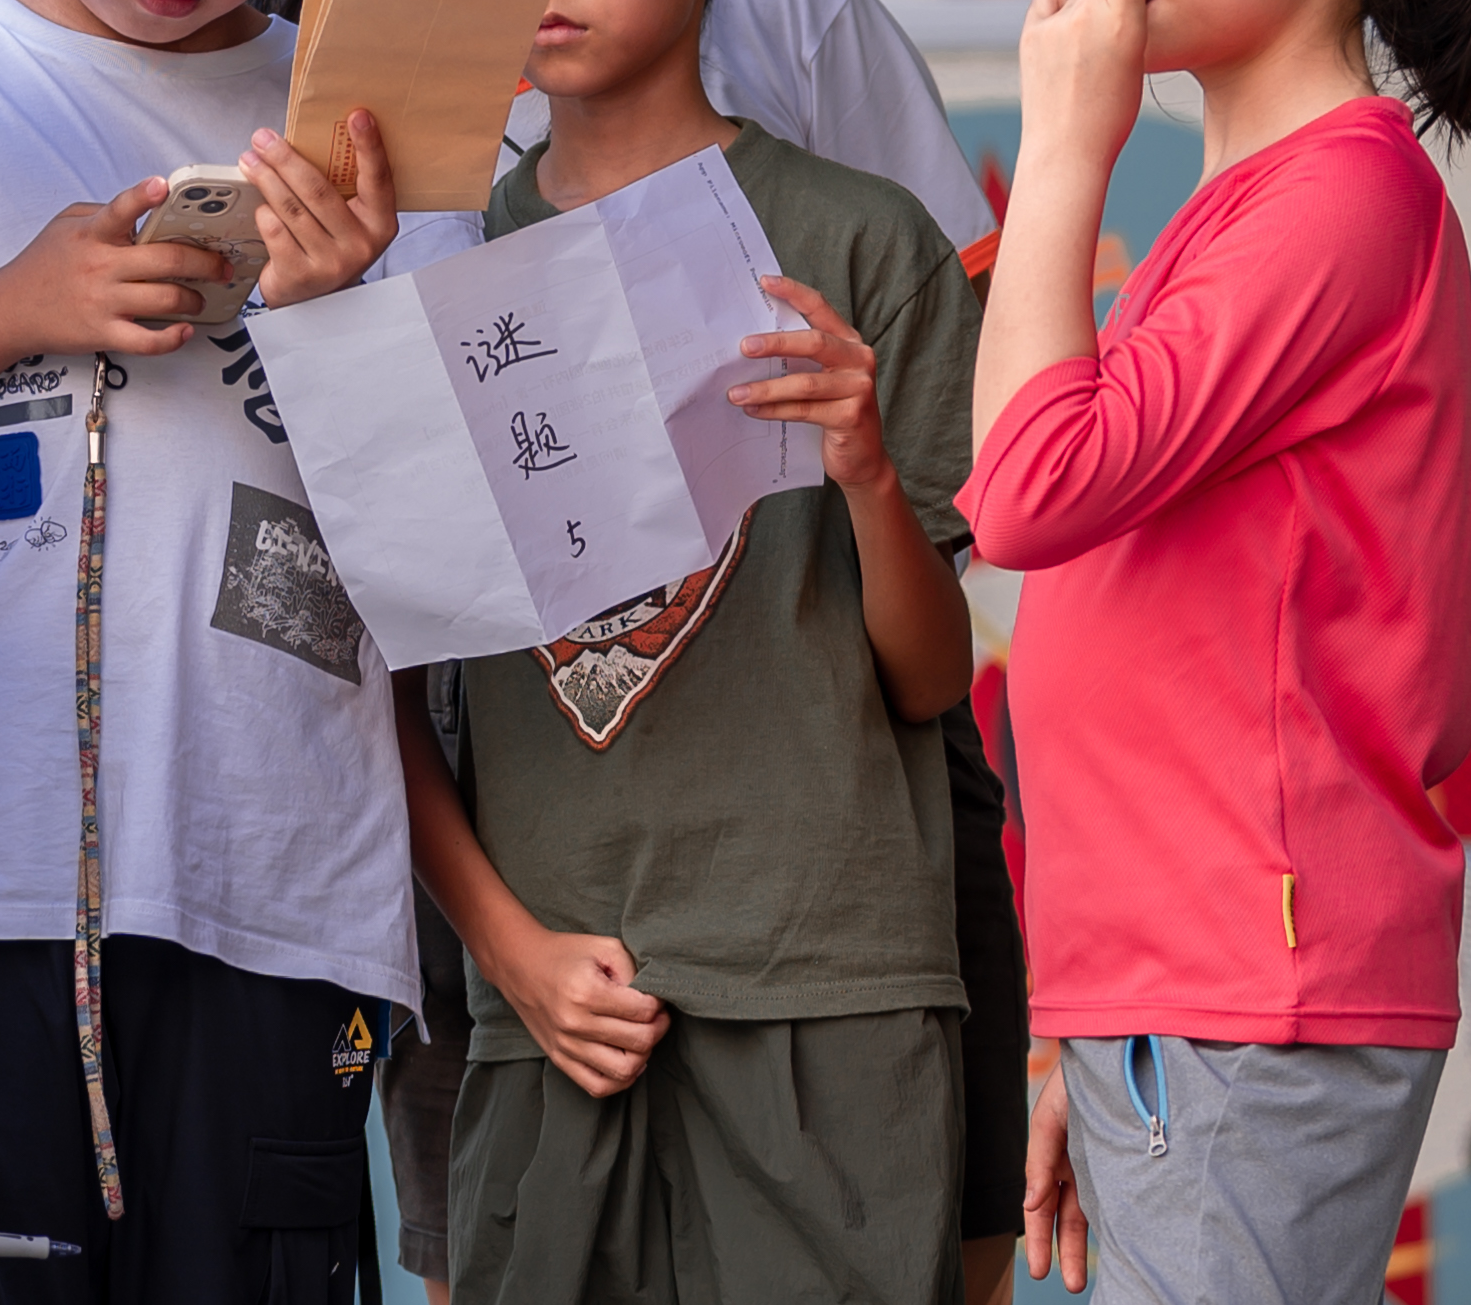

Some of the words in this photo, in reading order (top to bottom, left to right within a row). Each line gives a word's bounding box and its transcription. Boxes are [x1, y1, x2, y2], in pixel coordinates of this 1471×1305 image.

[730, 221, 752, 265] Microsoft
[566, 519, 586, 559] 5
[572, 608, 643, 639] ARK
[332, 1050, 371, 1068] EXPLORE
